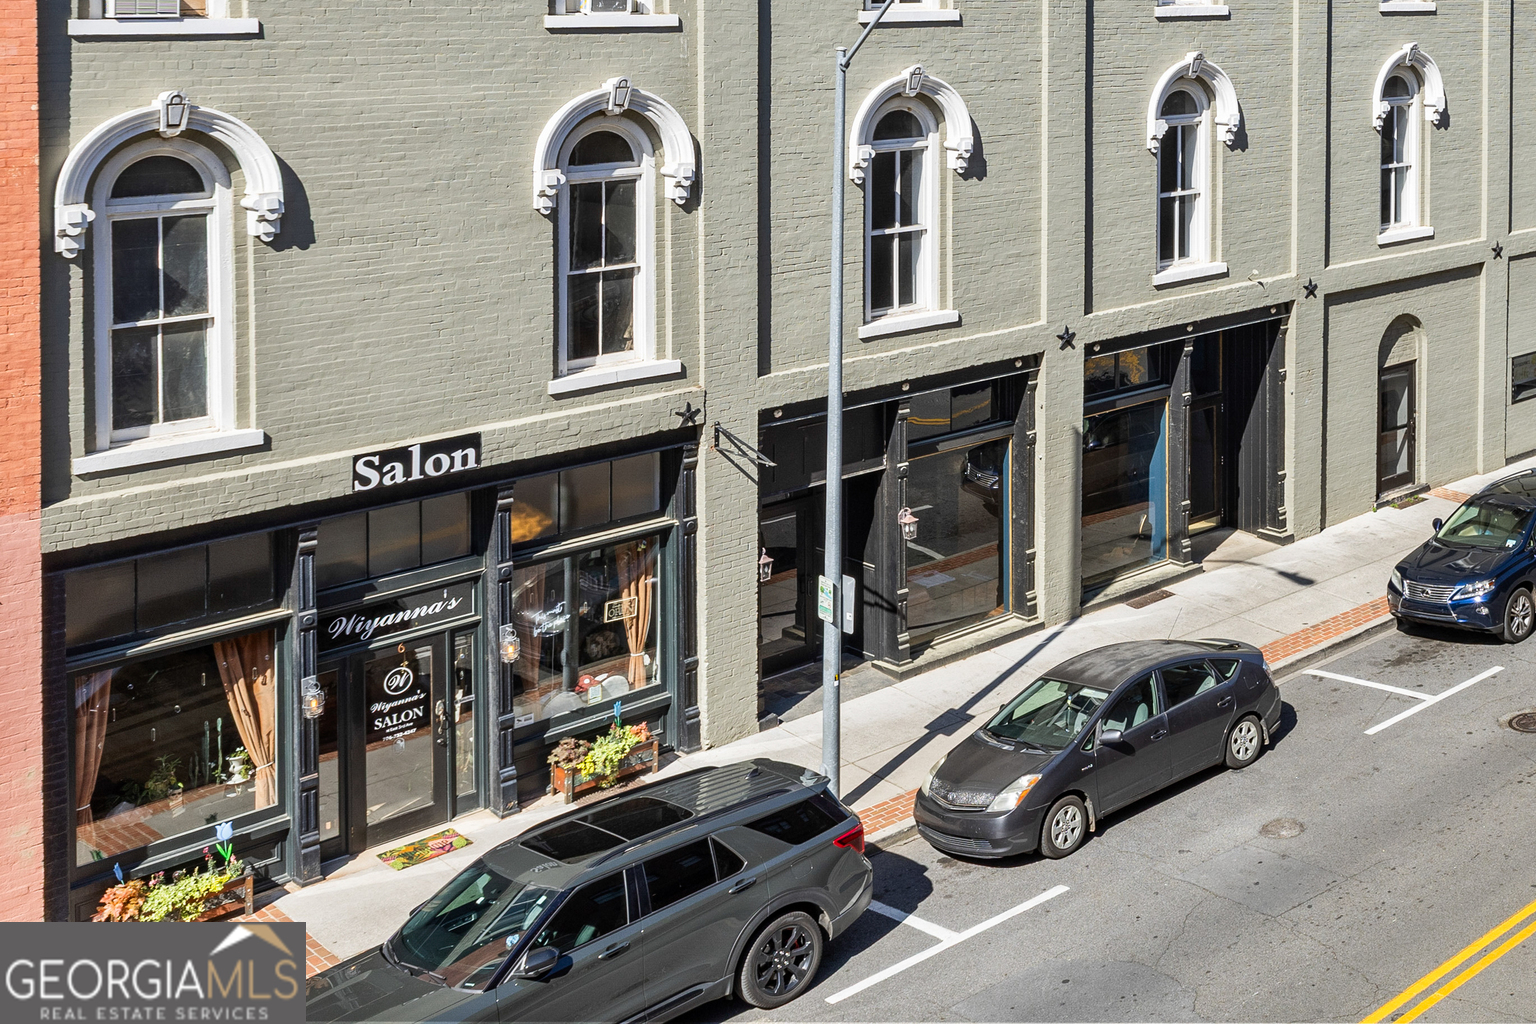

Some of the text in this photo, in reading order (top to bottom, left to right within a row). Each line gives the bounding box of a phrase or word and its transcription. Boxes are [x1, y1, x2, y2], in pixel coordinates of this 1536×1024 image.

[354, 443, 480, 492] Salon
[328, 588, 463, 641] Wiyanna's
[397, 642, 406, 653] 6
[370, 689, 427, 714] Wiyanna's
[374, 705, 425, 730] SALON
